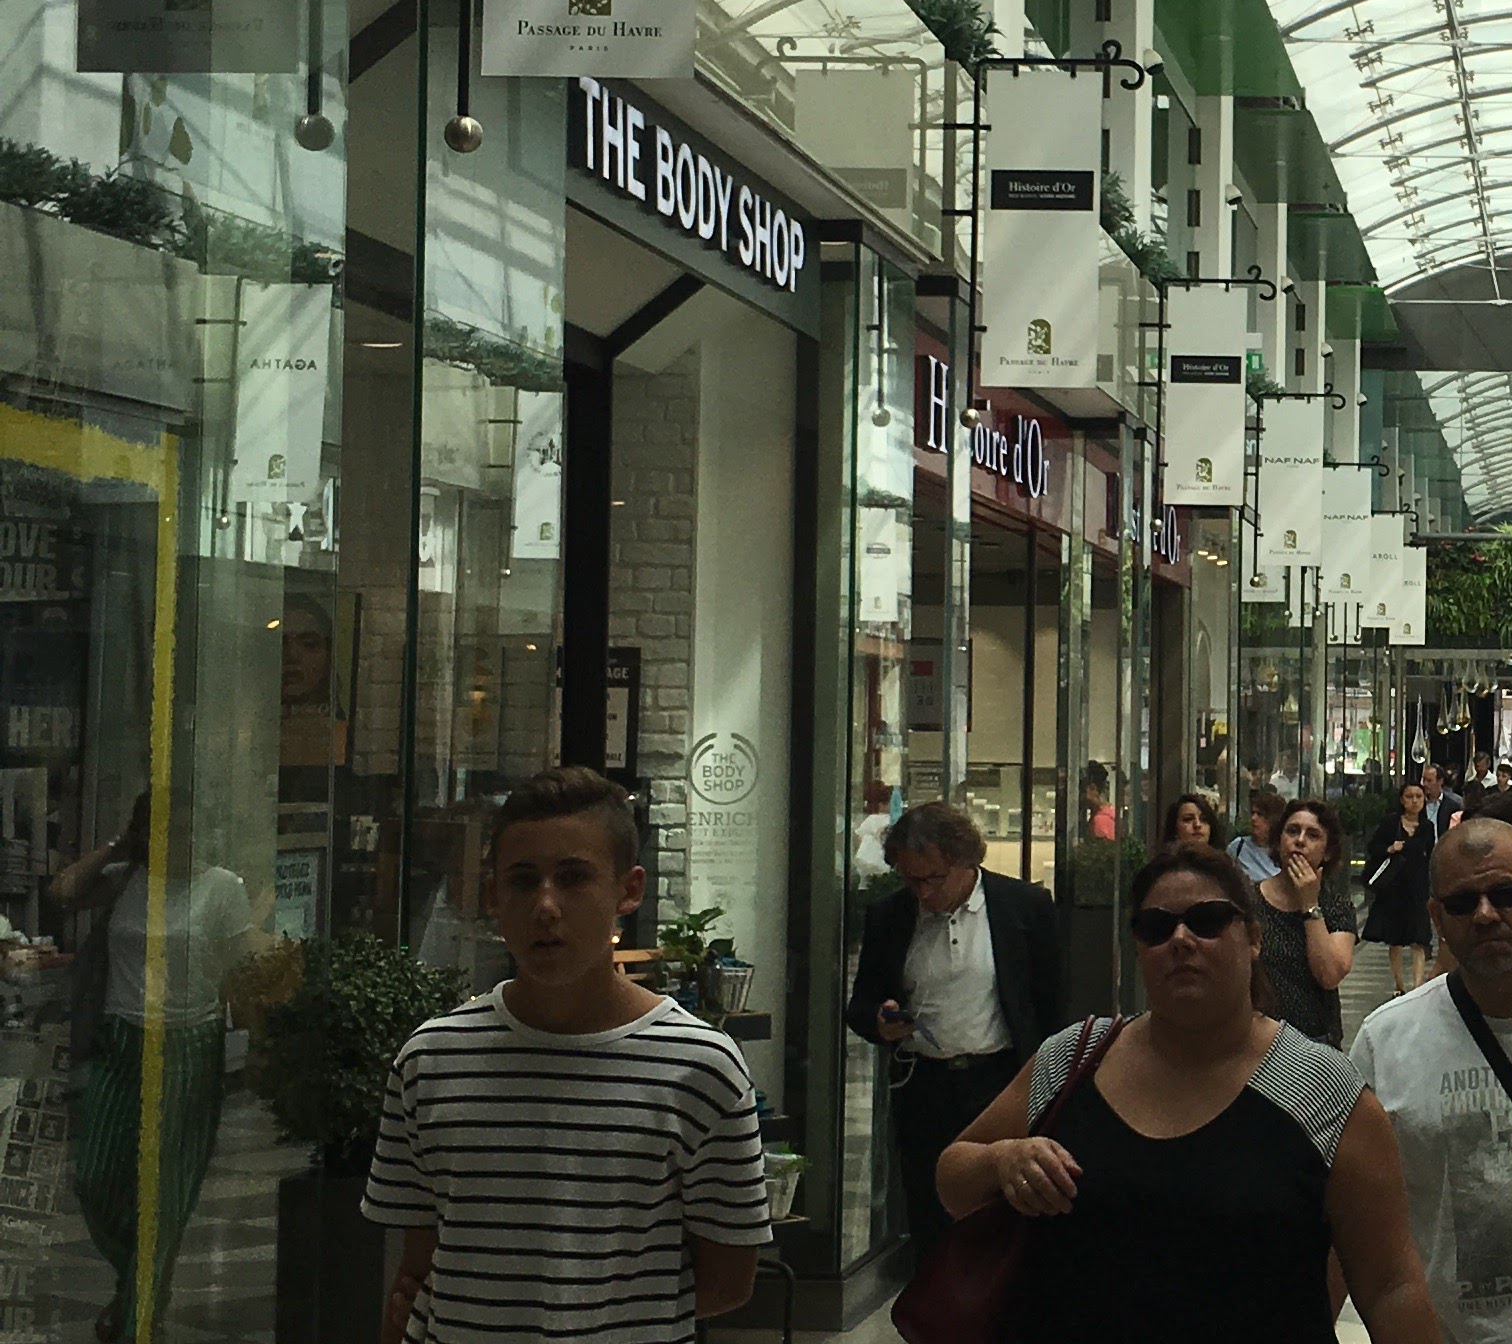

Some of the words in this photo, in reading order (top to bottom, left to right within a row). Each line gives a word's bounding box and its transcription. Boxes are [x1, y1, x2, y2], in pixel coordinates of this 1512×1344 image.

[579, 76, 646, 201] THE
[656, 125, 733, 252] BODY
[739, 185, 804, 293] SHOP
[1008, 181, 1050, 192] Histoire
[1052, 181, 1076, 192] d'Or
[1013, 414, 1050, 498] d'Or
[1264, 457, 1292, 465] NAF
[1293, 457, 1321, 465] NAF
[711, 753, 737, 764] THE
[702, 765, 746, 778] BODY
[703, 779, 745, 792] SHOP
